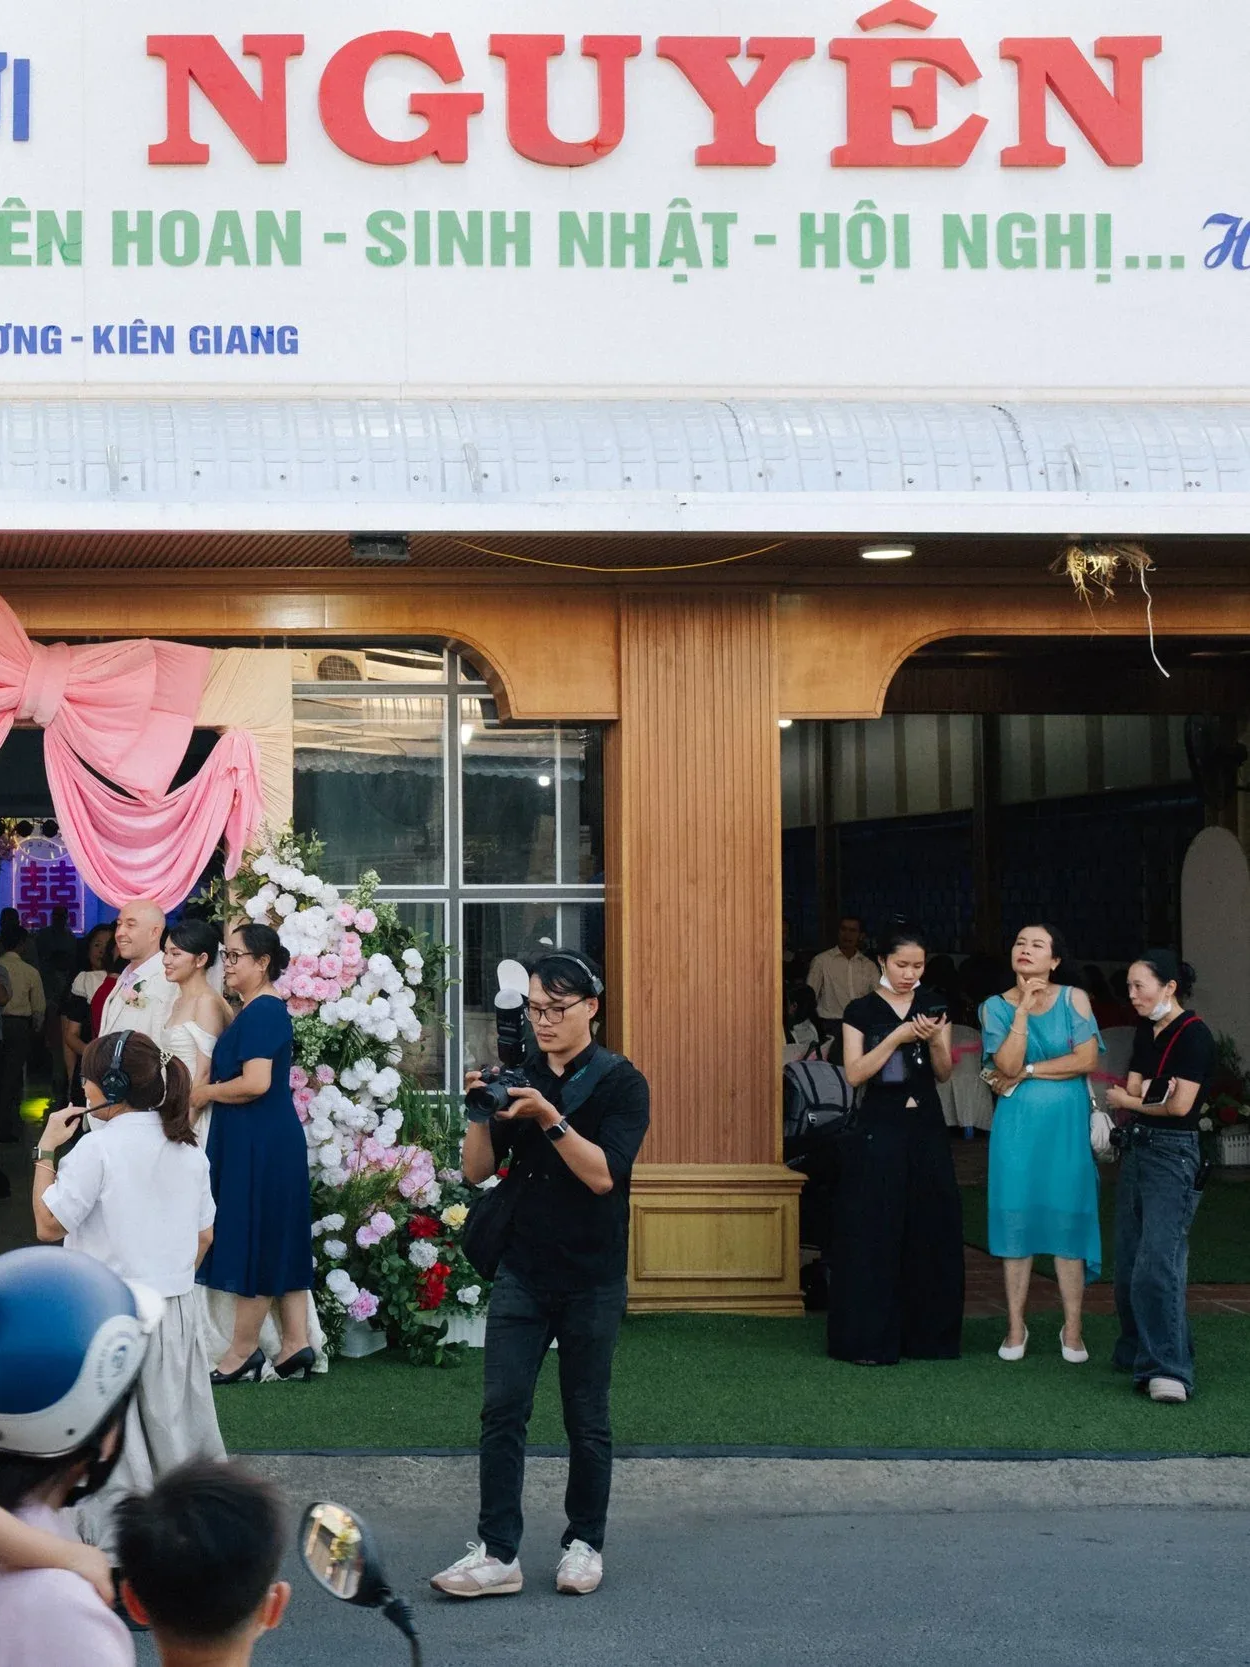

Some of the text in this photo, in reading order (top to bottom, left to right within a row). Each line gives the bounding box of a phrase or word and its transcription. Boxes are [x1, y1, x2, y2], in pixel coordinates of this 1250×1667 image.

[148, 0, 1162, 168] NGUYÊN
[112, 211, 302, 267] HOAN
[366, 210, 532, 268] SINH
[559, 197, 739, 283] NHẬT
[800, 200, 912, 283] HỘI
[93, 319, 175, 355] KIÊN
[190, 324, 300, 356] GIANG
